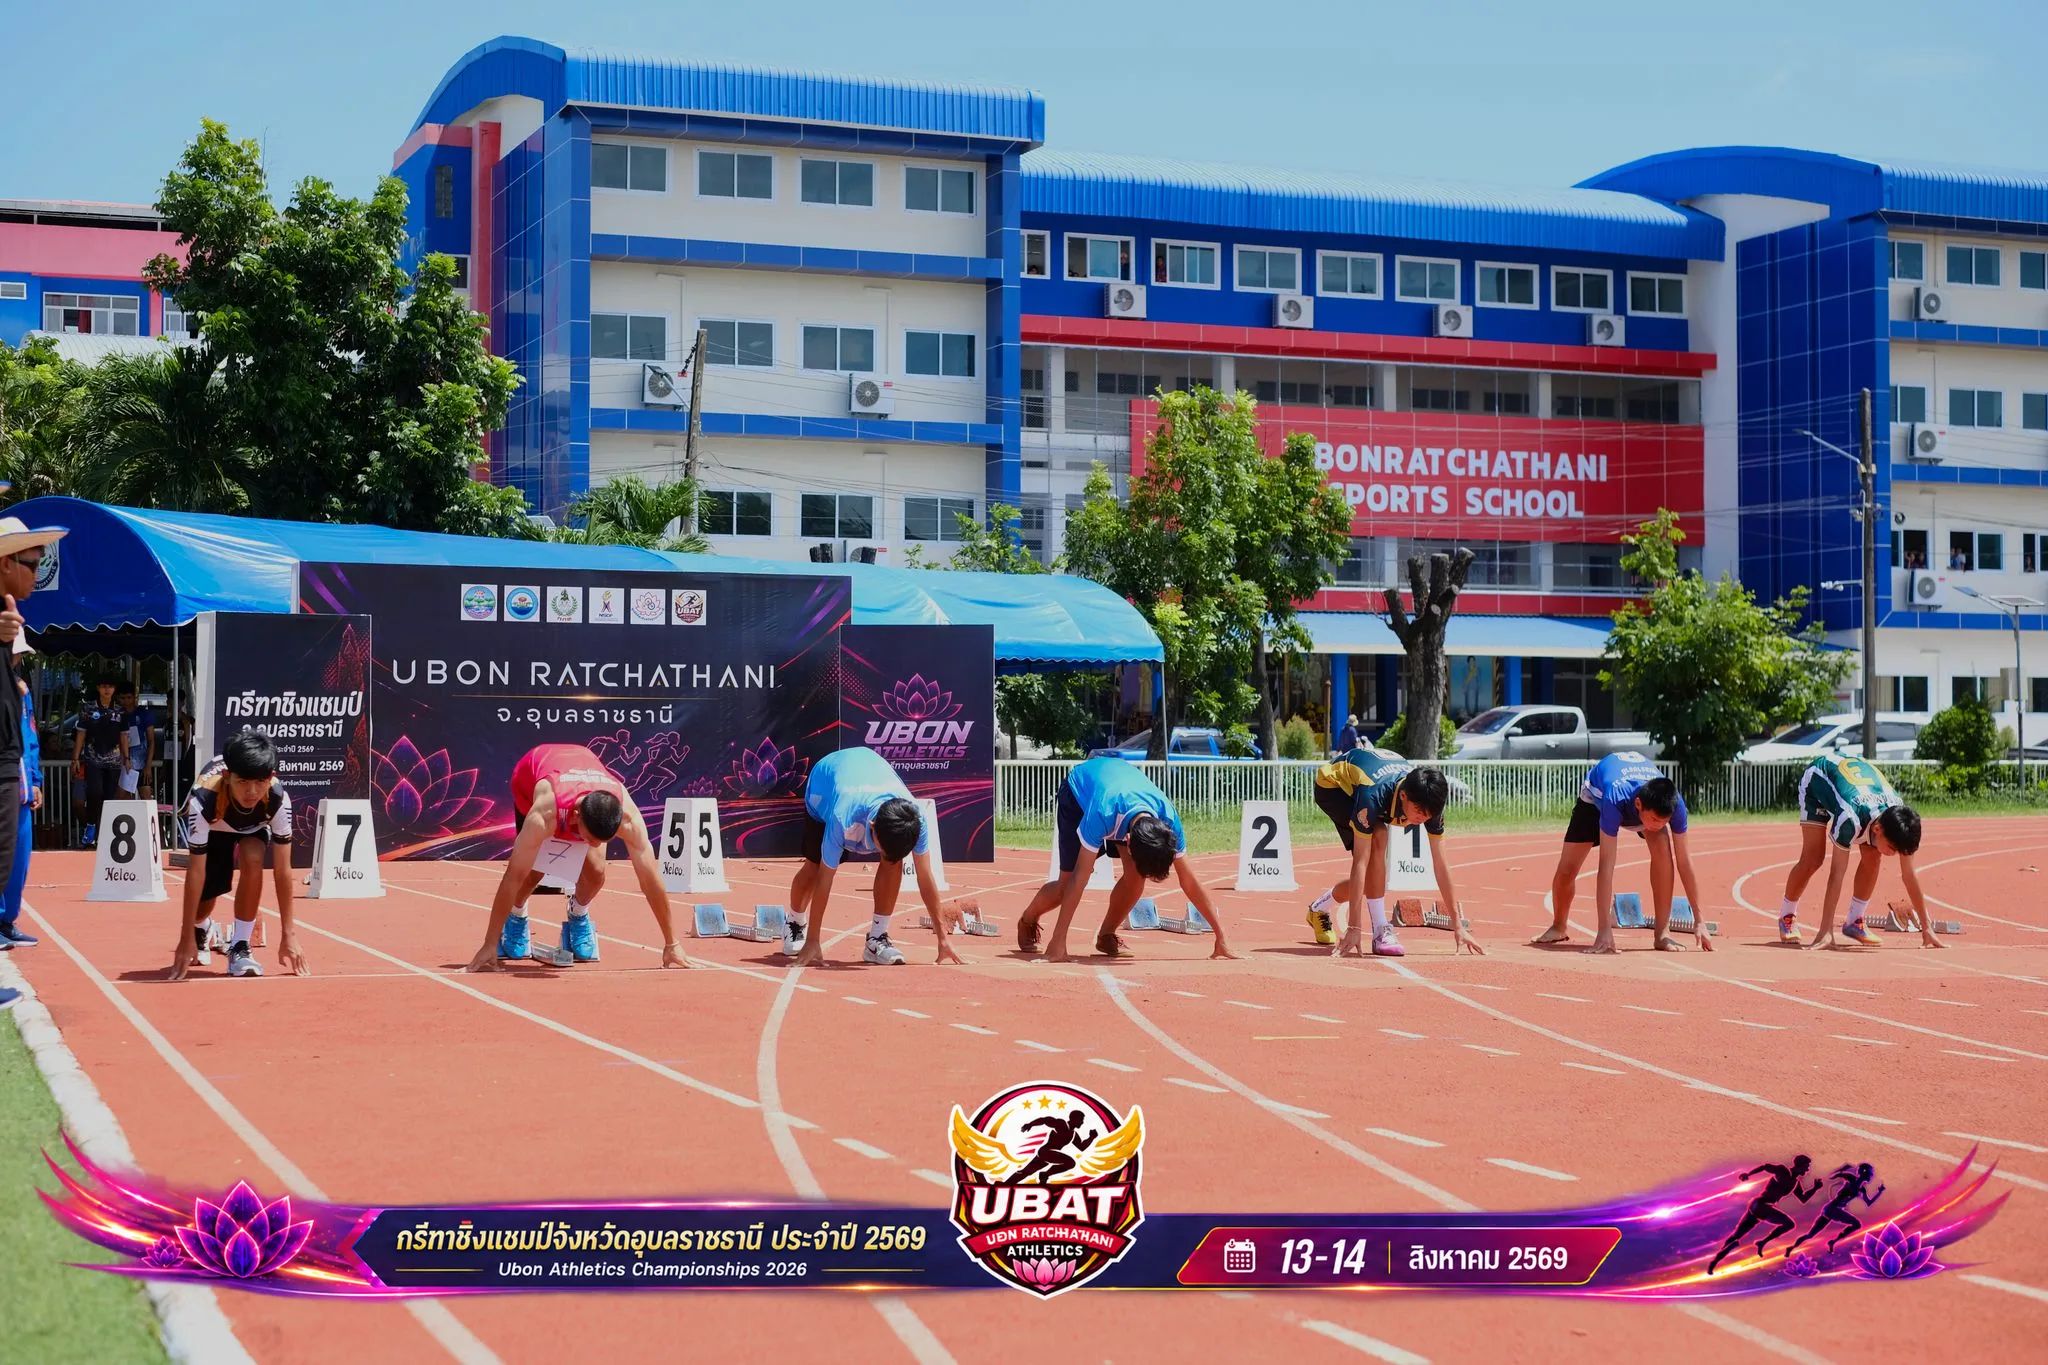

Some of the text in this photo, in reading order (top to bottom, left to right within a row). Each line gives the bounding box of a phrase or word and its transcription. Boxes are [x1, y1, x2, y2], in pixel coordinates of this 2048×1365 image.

[1315, 442, 1607, 482] BONRATCHATHANI
[1466, 487, 1585, 519] SCHOOL
[392, 659, 776, 689] UBON RATCHATHANI
[497, 704, 673, 729] จ.อุบลราชธานี
[864, 720, 975, 744] UBON
[297, 745, 315, 753] 2569
[278, 760, 345, 772] สิงหาคม 2569
[110, 813, 136, 863] 8
[337, 814, 361, 862] 7
[667, 812, 685, 859] 5
[699, 812, 712, 858] 5
[1252, 815, 1278, 859] 2
[1404, 823, 1420, 858] 1
[548, 839, 571, 864] 7
[105, 867, 136, 881] Nelco
[333, 866, 364, 880] Nelco
[1248, 863, 1280, 876] Nelco
[1398, 861, 1425, 874] Nelco
